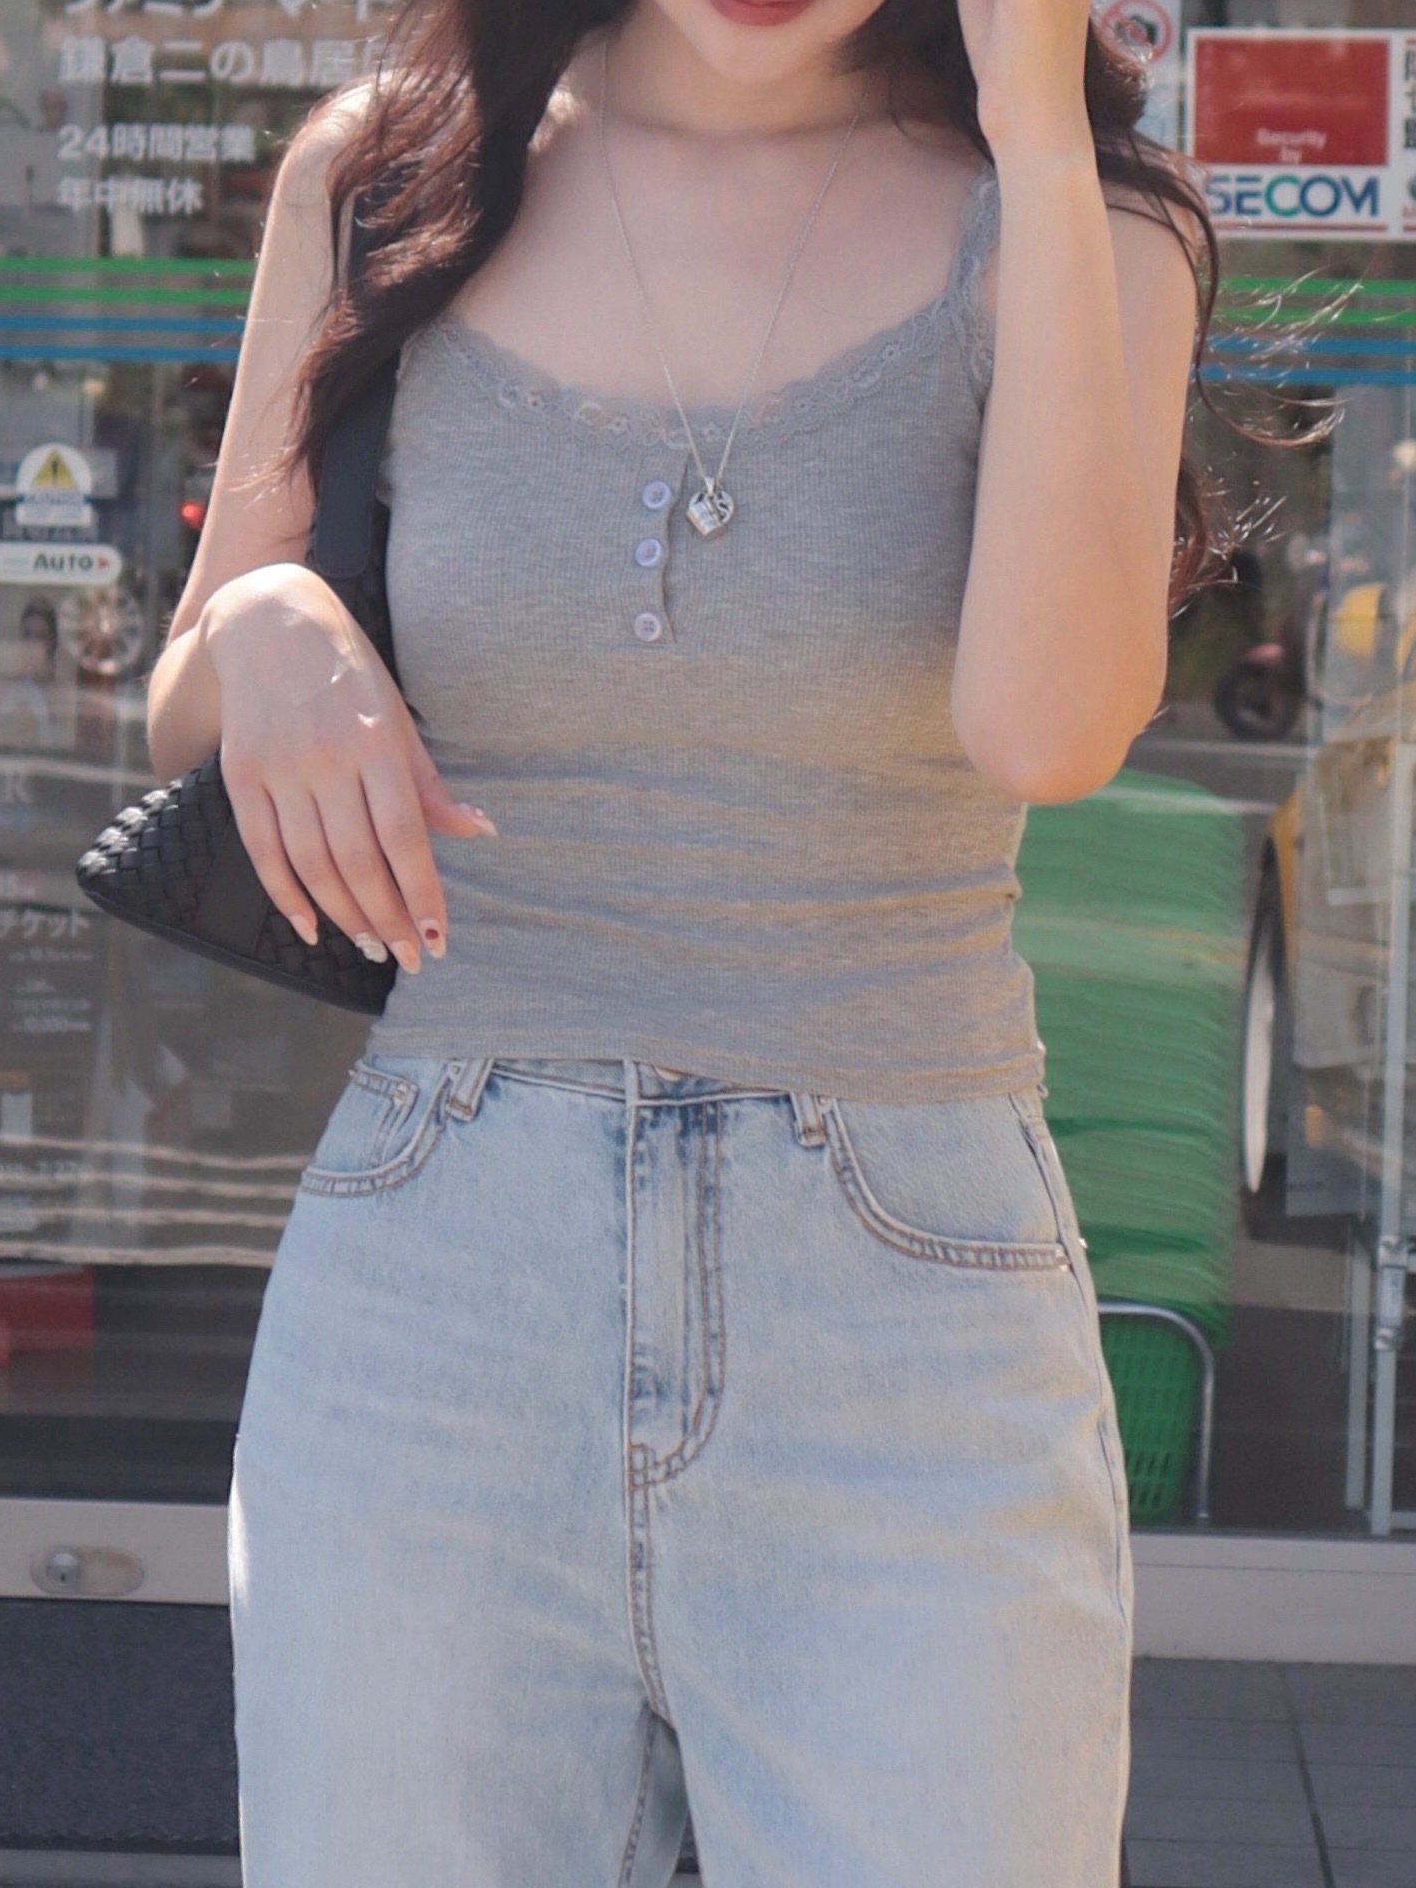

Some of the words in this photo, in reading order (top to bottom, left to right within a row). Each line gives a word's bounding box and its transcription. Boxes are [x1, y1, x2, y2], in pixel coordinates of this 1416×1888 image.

[57, 123, 257, 162] 24時間営業
[1255, 127, 1328, 151] Security
[57, 175, 205, 214] 年中無休
[1207, 173, 1379, 218] SECOM
[33, 551, 95, 571] Auto
